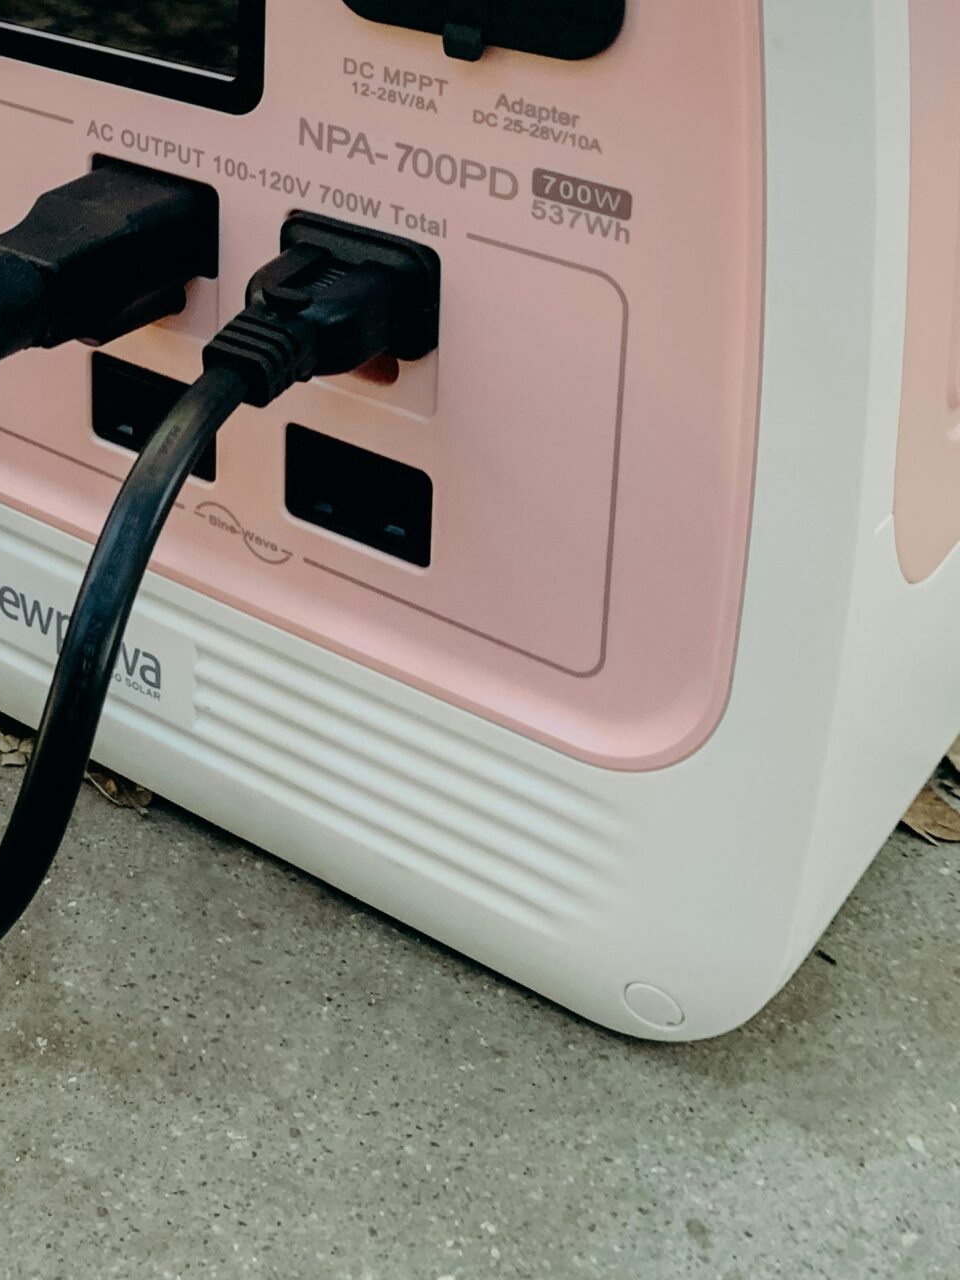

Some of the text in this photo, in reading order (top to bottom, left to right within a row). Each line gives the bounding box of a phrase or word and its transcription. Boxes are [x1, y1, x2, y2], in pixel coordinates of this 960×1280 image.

[343, 57, 448, 97] DC MPPT
[351, 80, 438, 114] 12-28V/8A
[495, 94, 580, 128] Adapter
[472, 109, 603, 154] DC 25-28V/10A
[298, 117, 519, 200] NPA-700PD
[86, 120, 447, 239] AC OUTPUT 100-120V 700W Total
[542, 173, 623, 213] 700W
[531, 199, 631, 244] 537Wh
[125, 677, 161, 701] SOLAR
